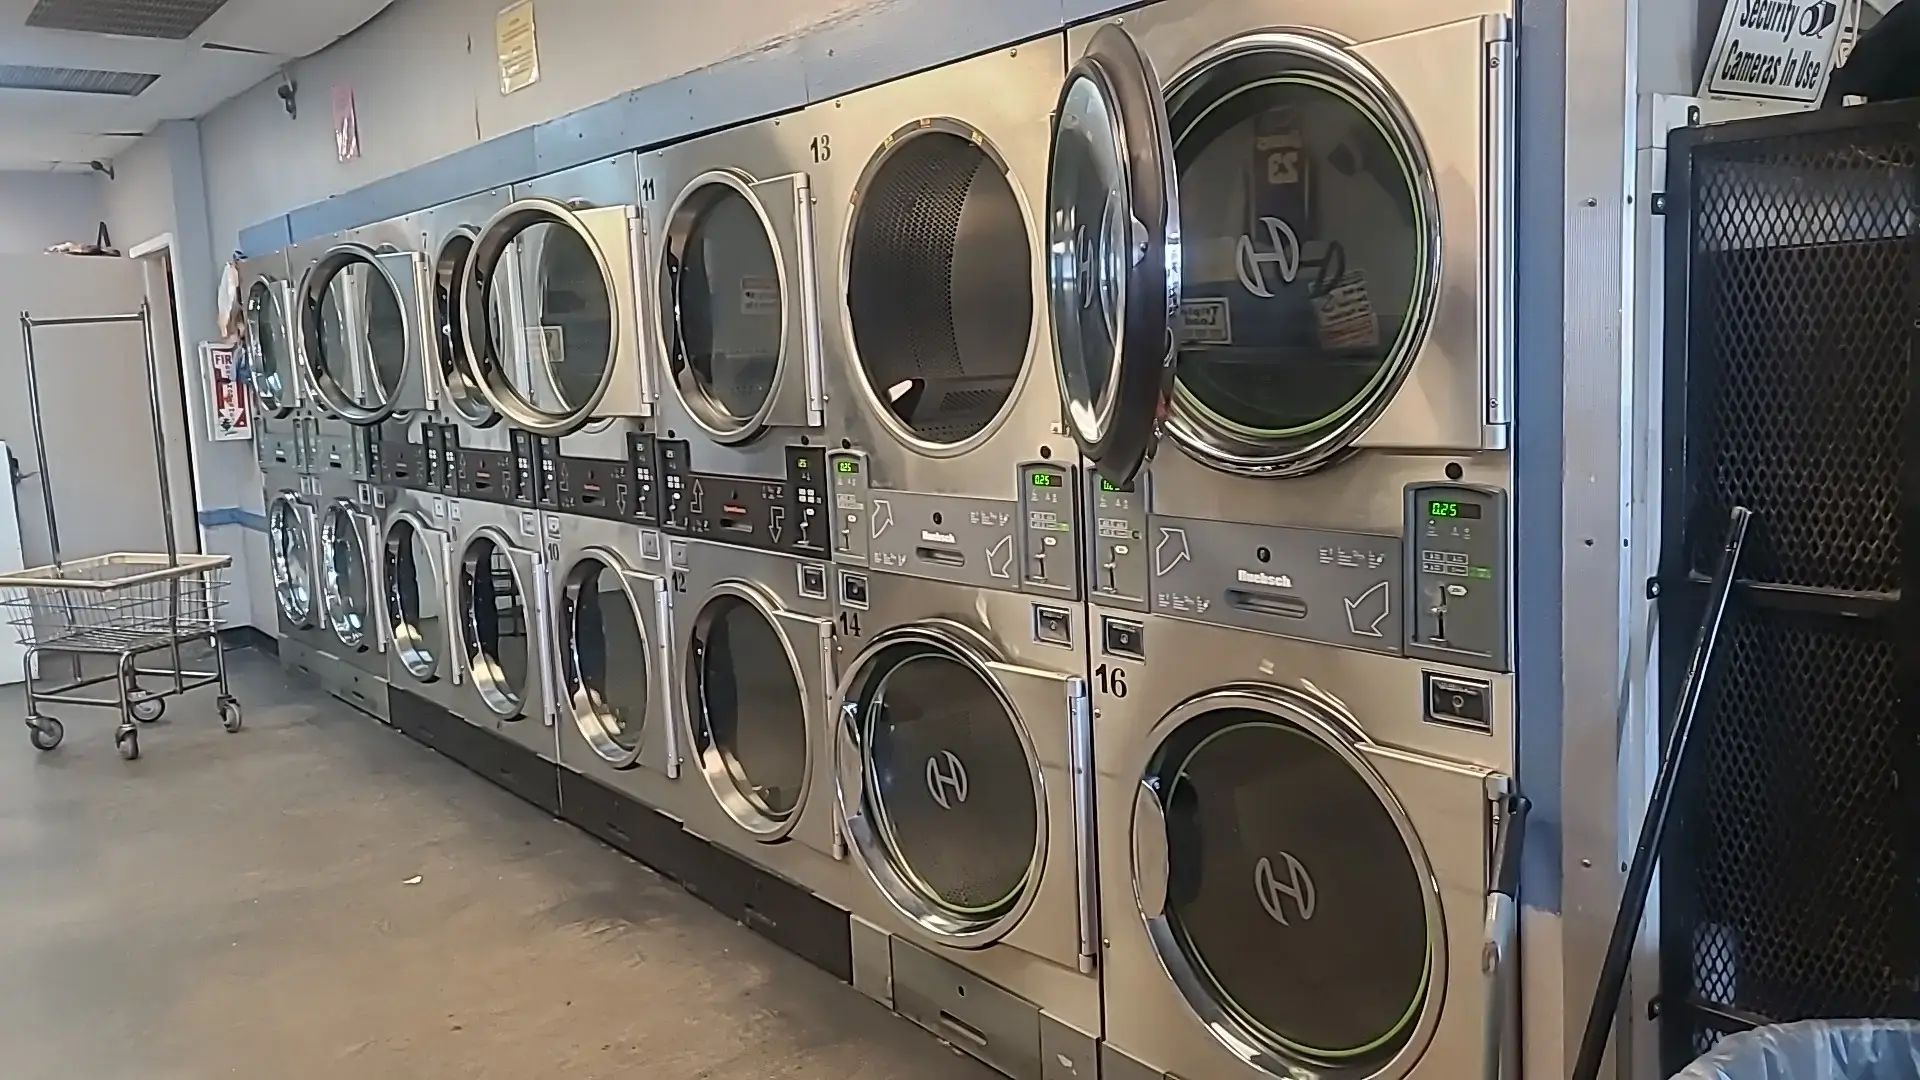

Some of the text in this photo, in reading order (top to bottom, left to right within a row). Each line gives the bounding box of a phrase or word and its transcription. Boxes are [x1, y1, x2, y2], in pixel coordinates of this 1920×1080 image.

[1739, 0, 1801, 43] Security
[1721, 39, 1821, 90] Cameras In Use
[810, 134, 831, 163] 13
[642, 178, 655, 201] 11
[215, 354, 233, 365] FIR
[547, 542, 560, 561] 10
[671, 571, 687, 593] 12
[839, 611, 861, 638] 14
[1095, 663, 1128, 699] 16
